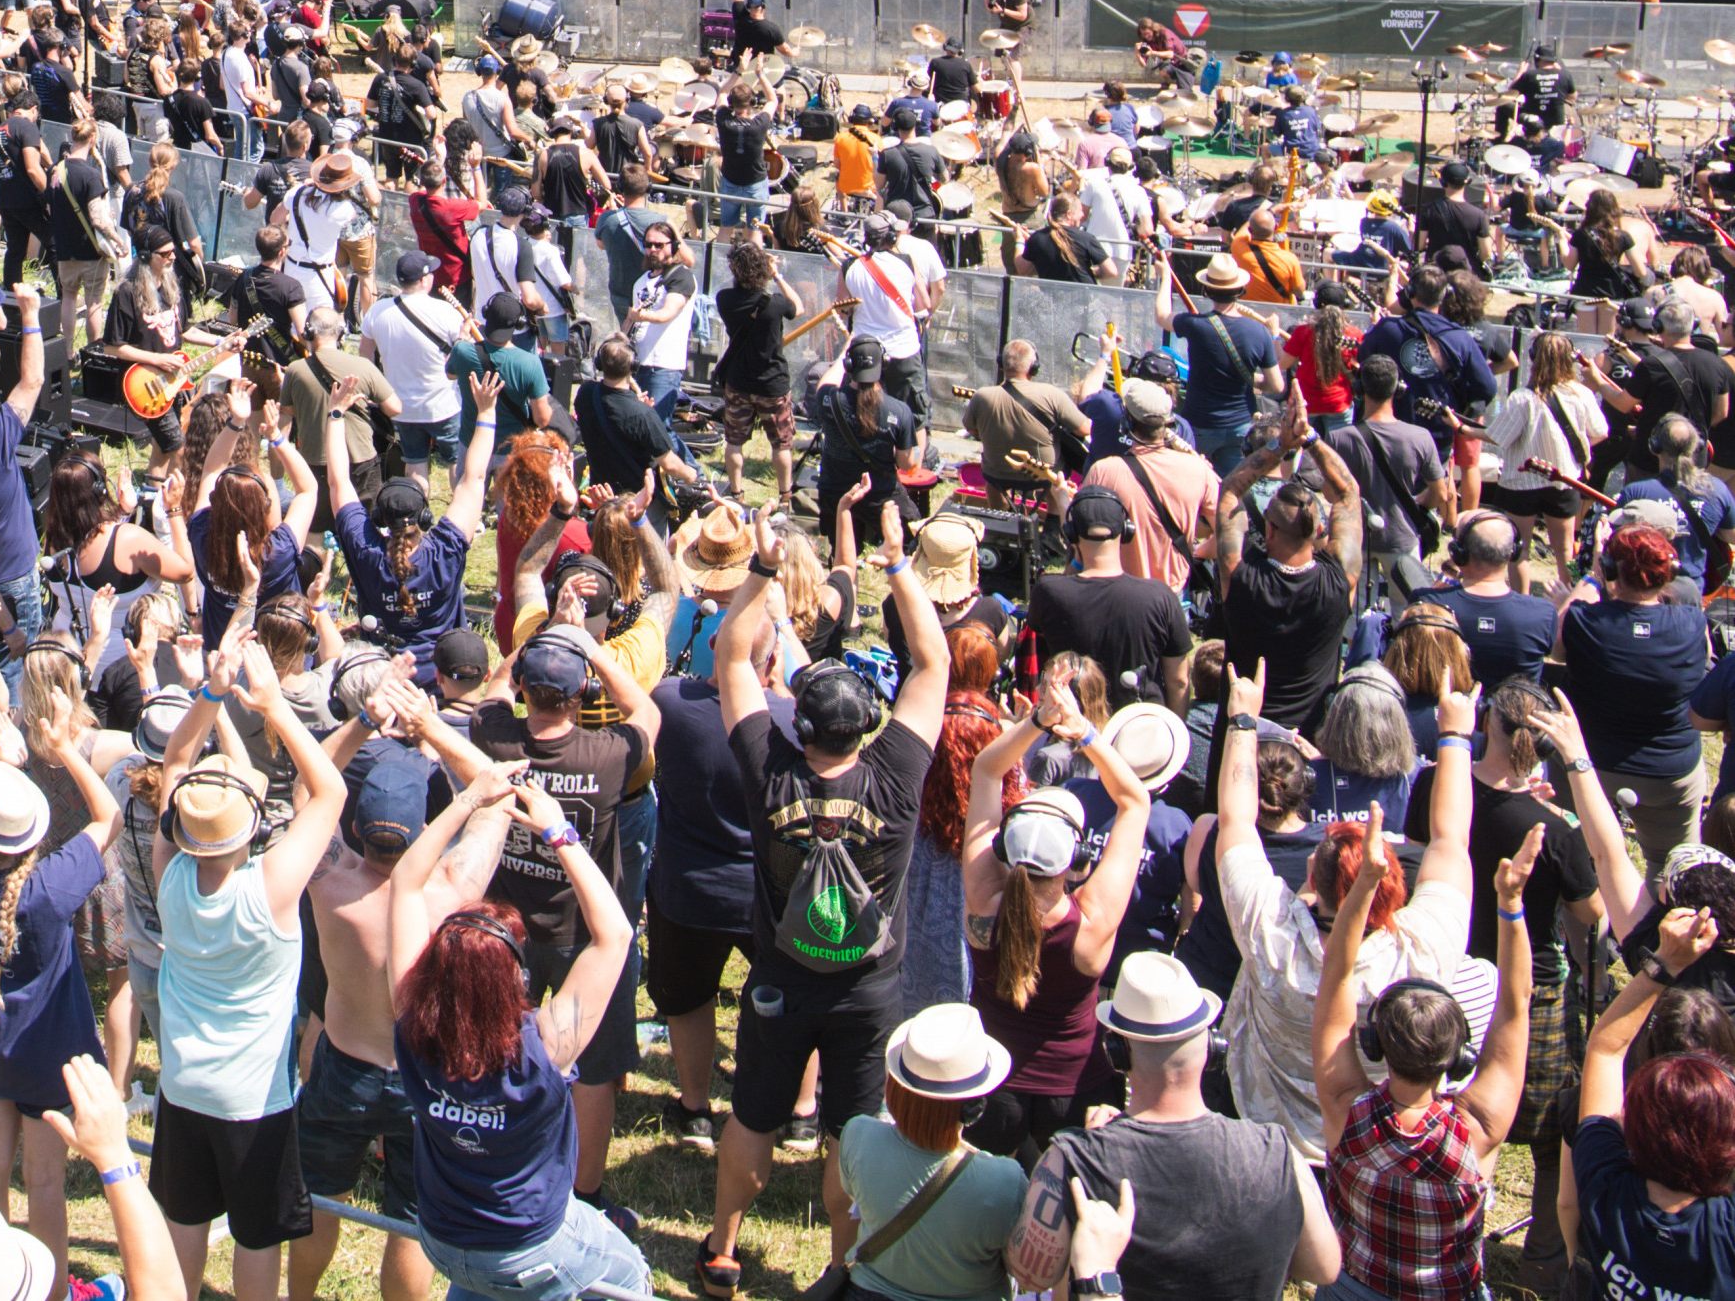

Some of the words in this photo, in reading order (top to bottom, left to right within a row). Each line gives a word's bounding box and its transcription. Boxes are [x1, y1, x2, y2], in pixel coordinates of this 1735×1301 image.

[1390, 9, 1424, 19] MISSION
[1381, 18, 1424, 29] VORWÄRTS
[1311, 809, 1337, 822] Ich
[1343, 810, 1369, 822] wa
[428, 1098, 506, 1130] dabei!
